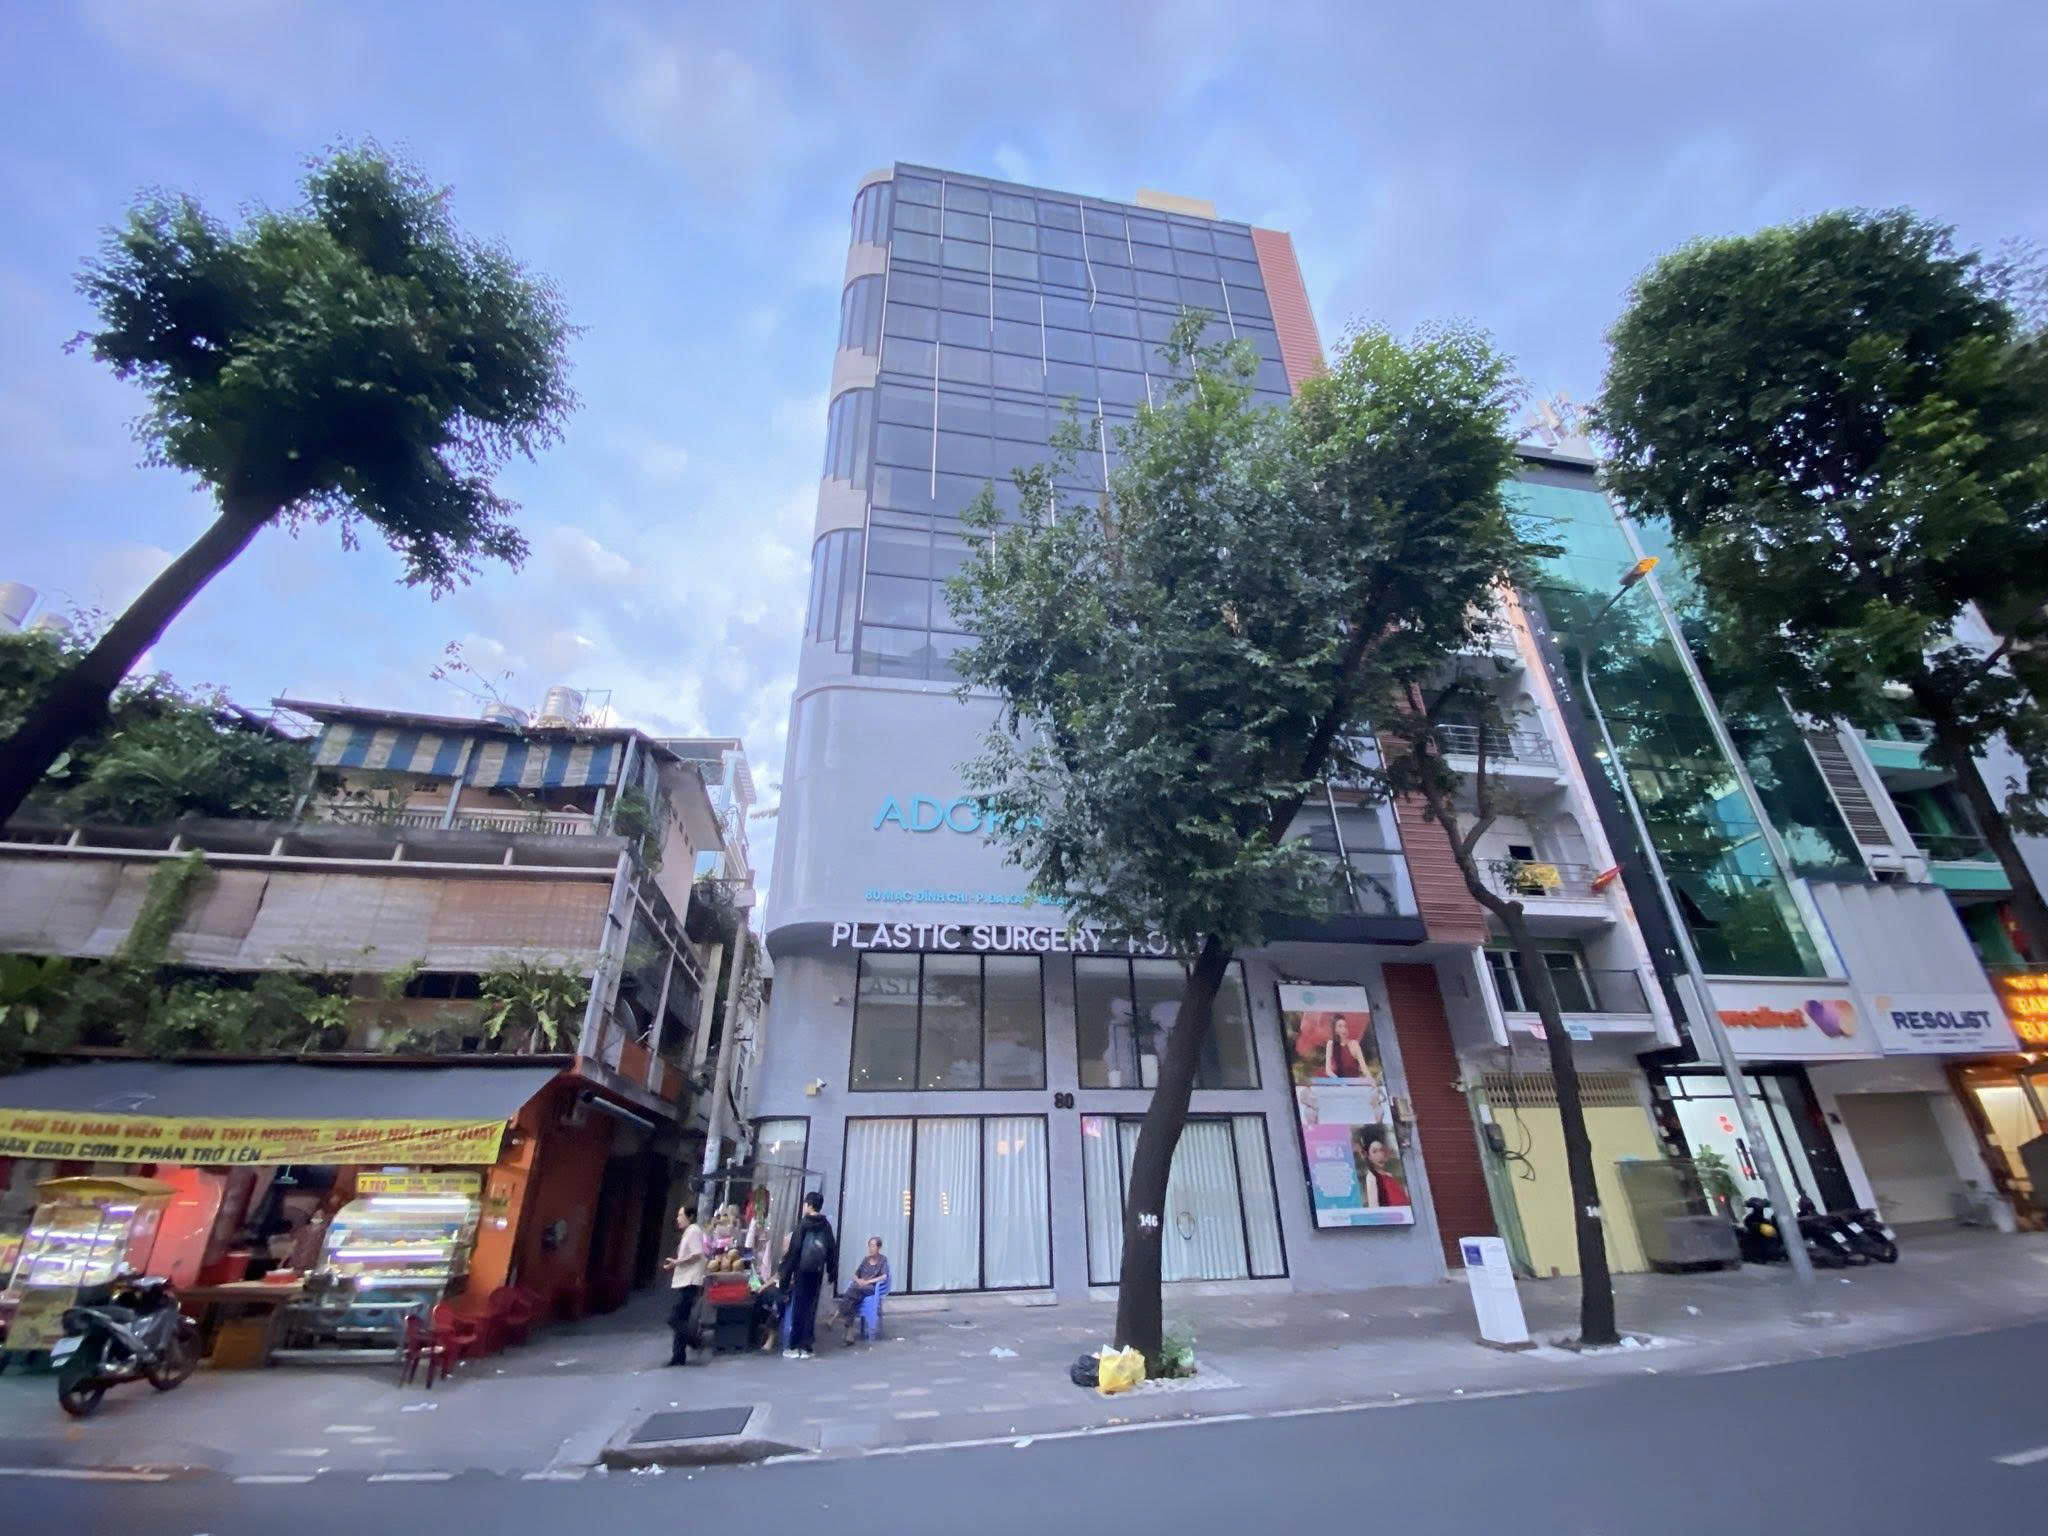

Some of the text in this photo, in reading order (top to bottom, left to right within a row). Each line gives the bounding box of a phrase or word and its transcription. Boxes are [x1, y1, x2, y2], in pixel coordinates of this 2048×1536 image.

[873, 793, 1045, 834] ADO
[831, 922, 961, 951] PLASTIC
[971, 925, 1102, 953] SURGERY
[1054, 1092, 1074, 1109] 80
[33, 1140, 75, 1156] GIAO
[123, 1145, 134, 1158] 2
